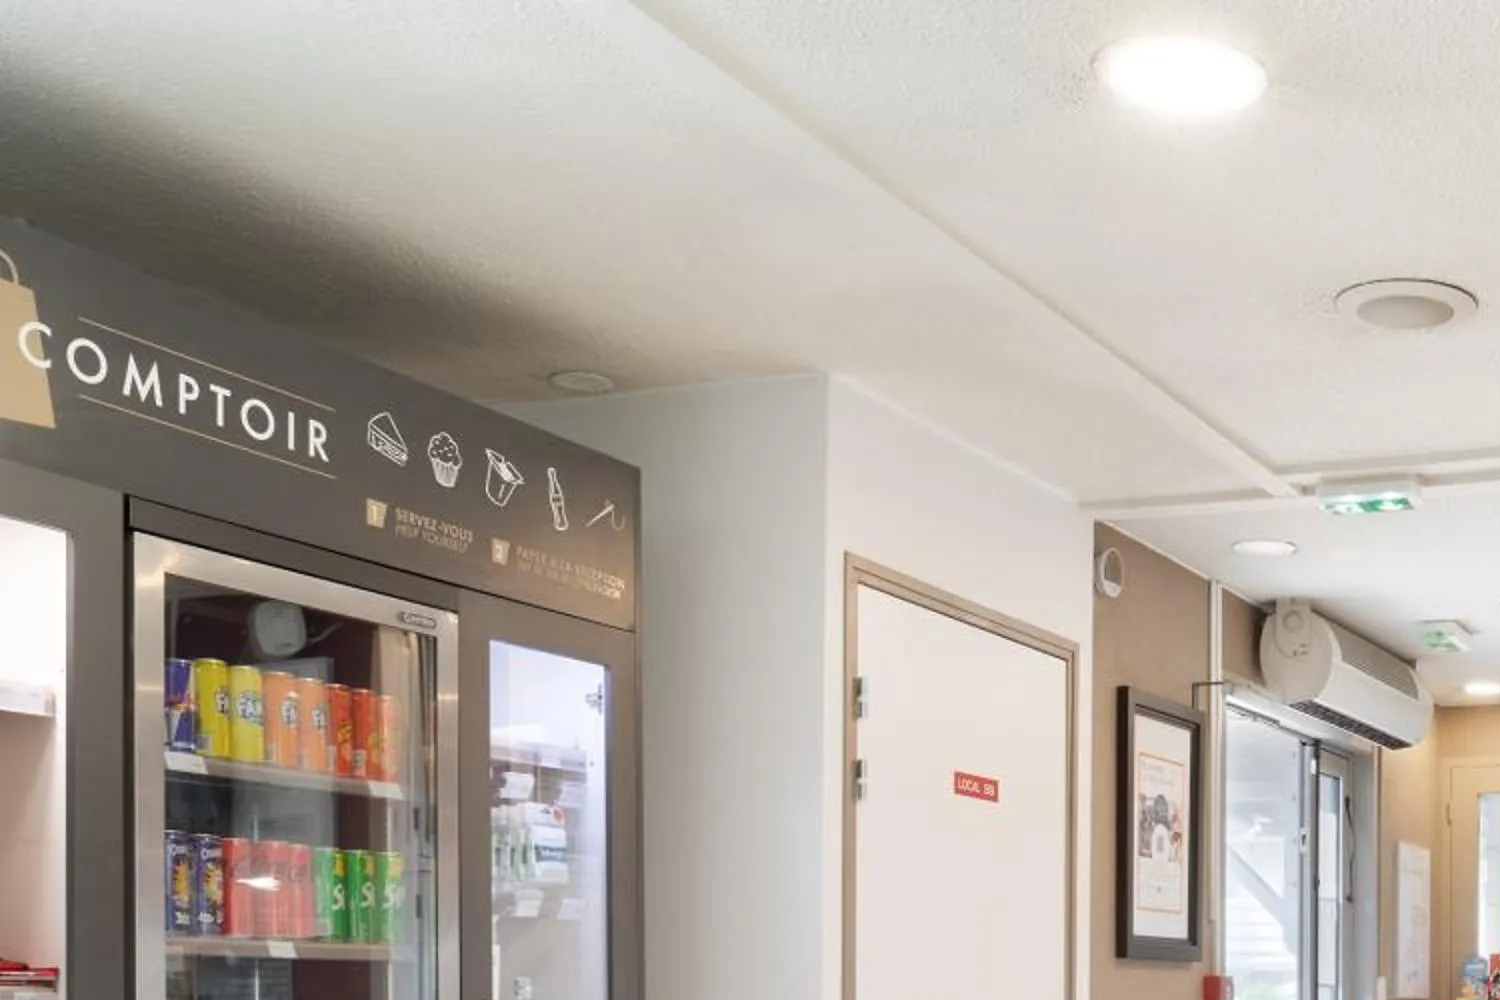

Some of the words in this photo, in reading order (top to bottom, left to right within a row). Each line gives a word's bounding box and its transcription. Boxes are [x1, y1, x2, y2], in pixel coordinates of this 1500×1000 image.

[17, 320, 329, 463] COMPTOIR
[395, 506, 473, 543] SERVEZ-VOUS
[957, 775, 981, 794] LOCAL
